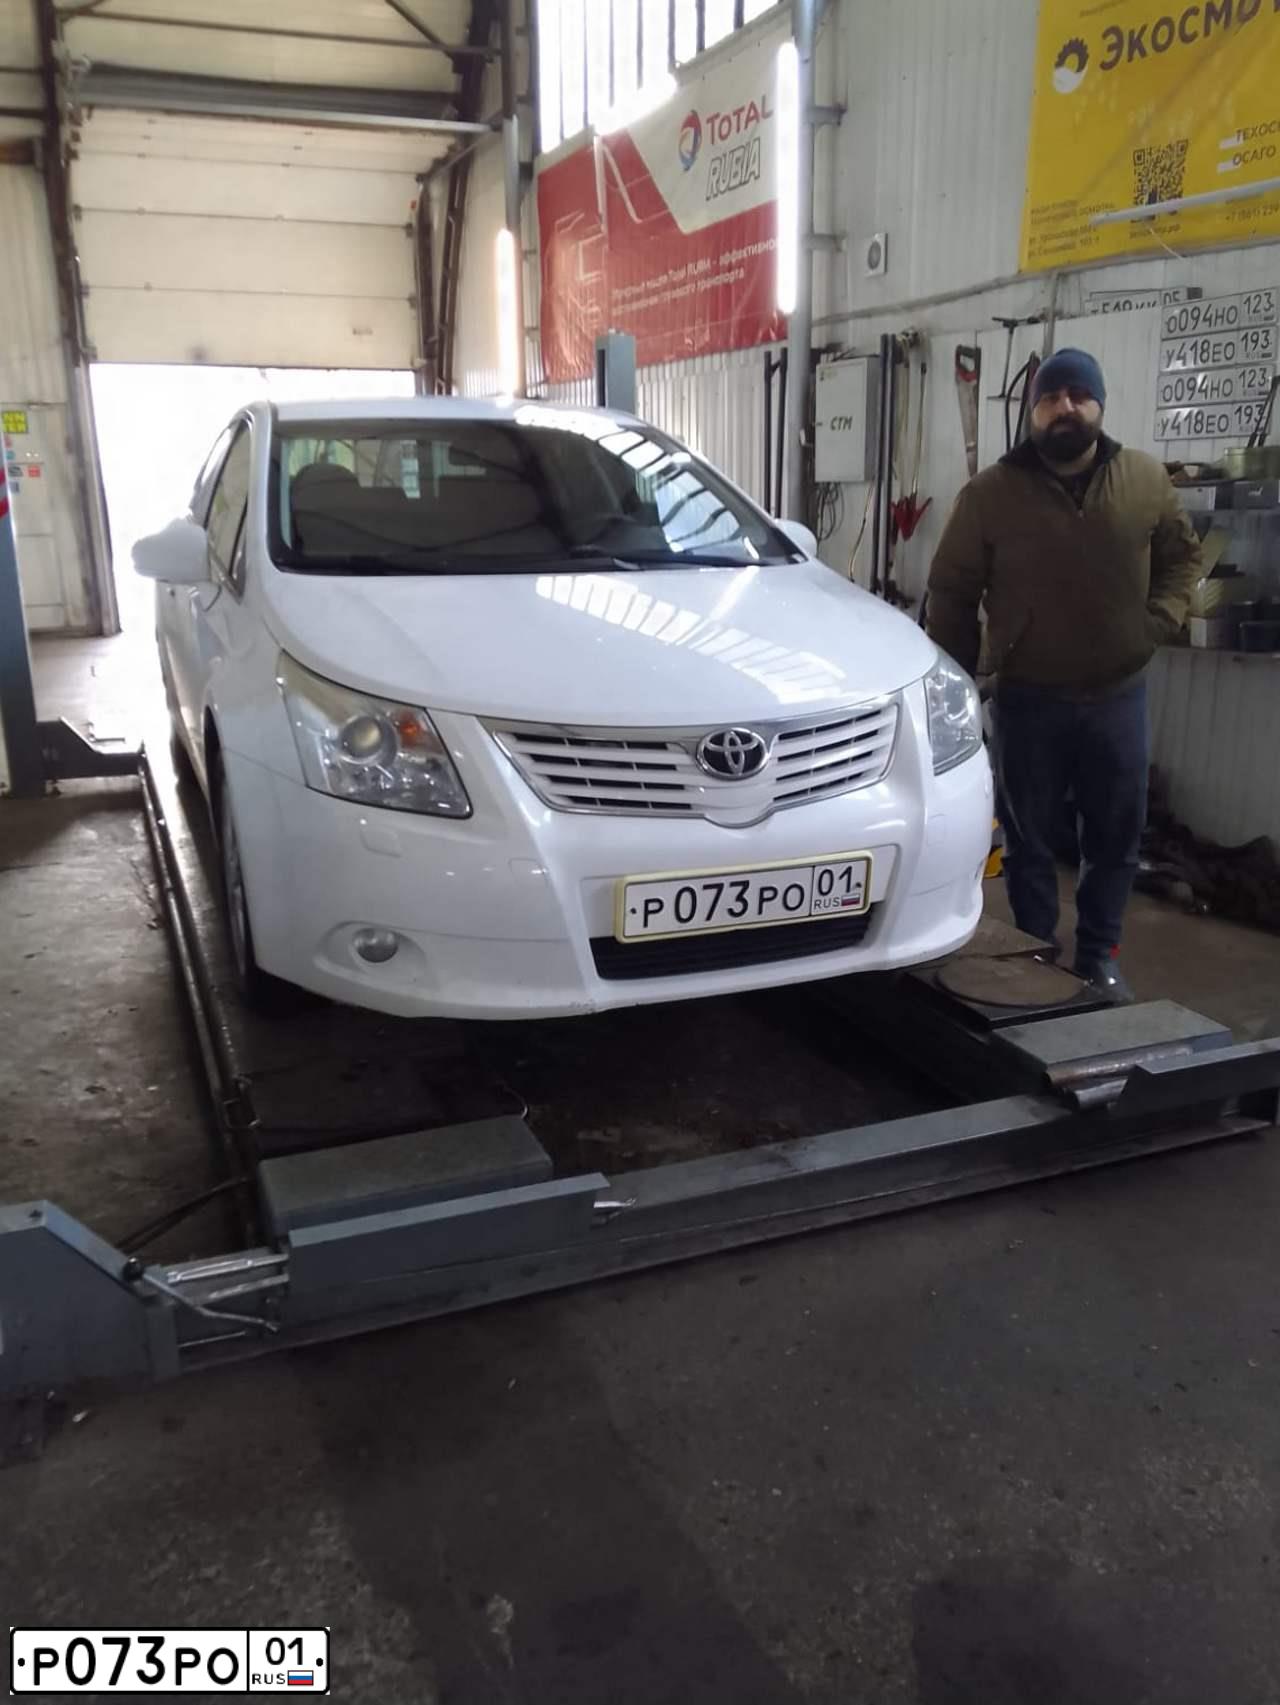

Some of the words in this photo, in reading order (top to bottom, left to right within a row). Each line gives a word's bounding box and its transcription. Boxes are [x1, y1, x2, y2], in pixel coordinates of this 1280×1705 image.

[1100, 0, 1280, 71] ЭКОСМО
[706, 95, 774, 145] TOTAL
[1236, 119, 1280, 142] ТЕХОС
[1232, 144, 1277, 166] ОСАГО
[706, 136, 761, 201] RUBIA
[1243, 292, 1274, 315] 123
[1241, 329, 1271, 353] 193
[1239, 367, 1267, 389] 123
[642, 880, 806, 929] Р073РО
[816, 866, 854, 897] 01
[813, 896, 841, 911] RUS
